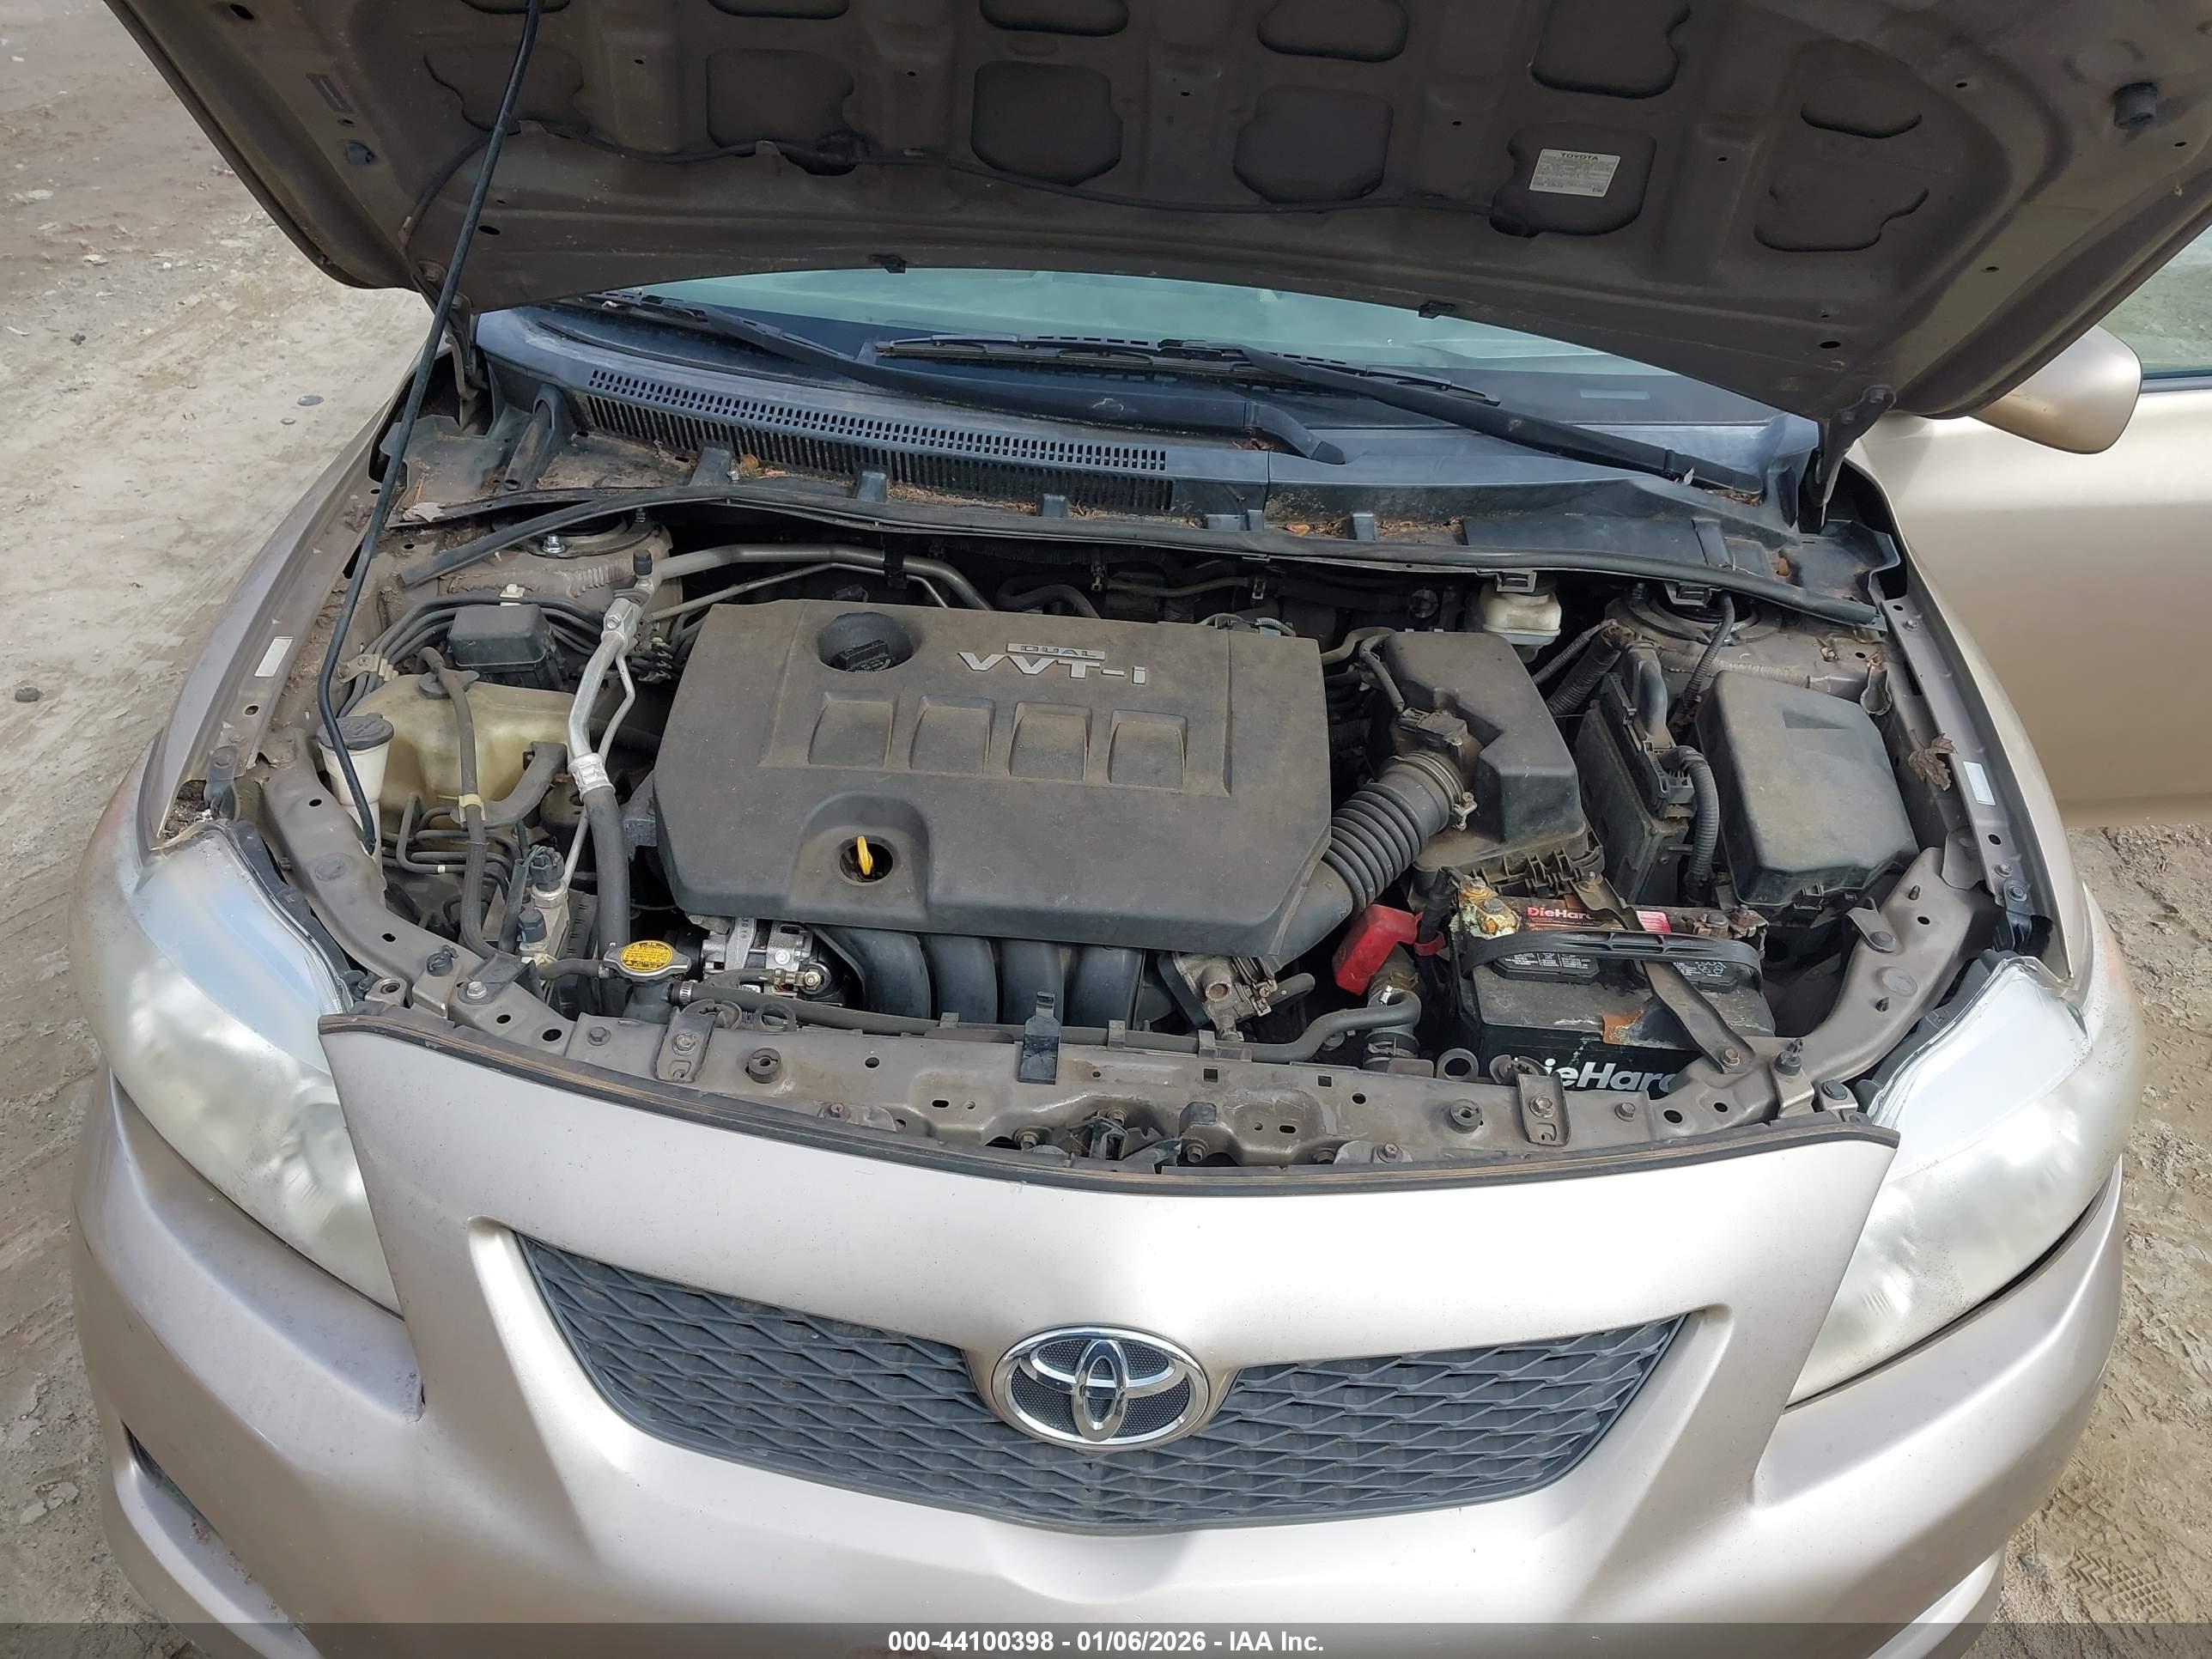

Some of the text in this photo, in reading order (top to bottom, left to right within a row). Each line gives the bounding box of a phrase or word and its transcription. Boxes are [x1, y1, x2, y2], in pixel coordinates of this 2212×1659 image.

[1560, 152, 1599, 161] TOYOTA
[1020, 645, 1097, 658] DUAL
[957, 652, 1146, 684] VVT-i
